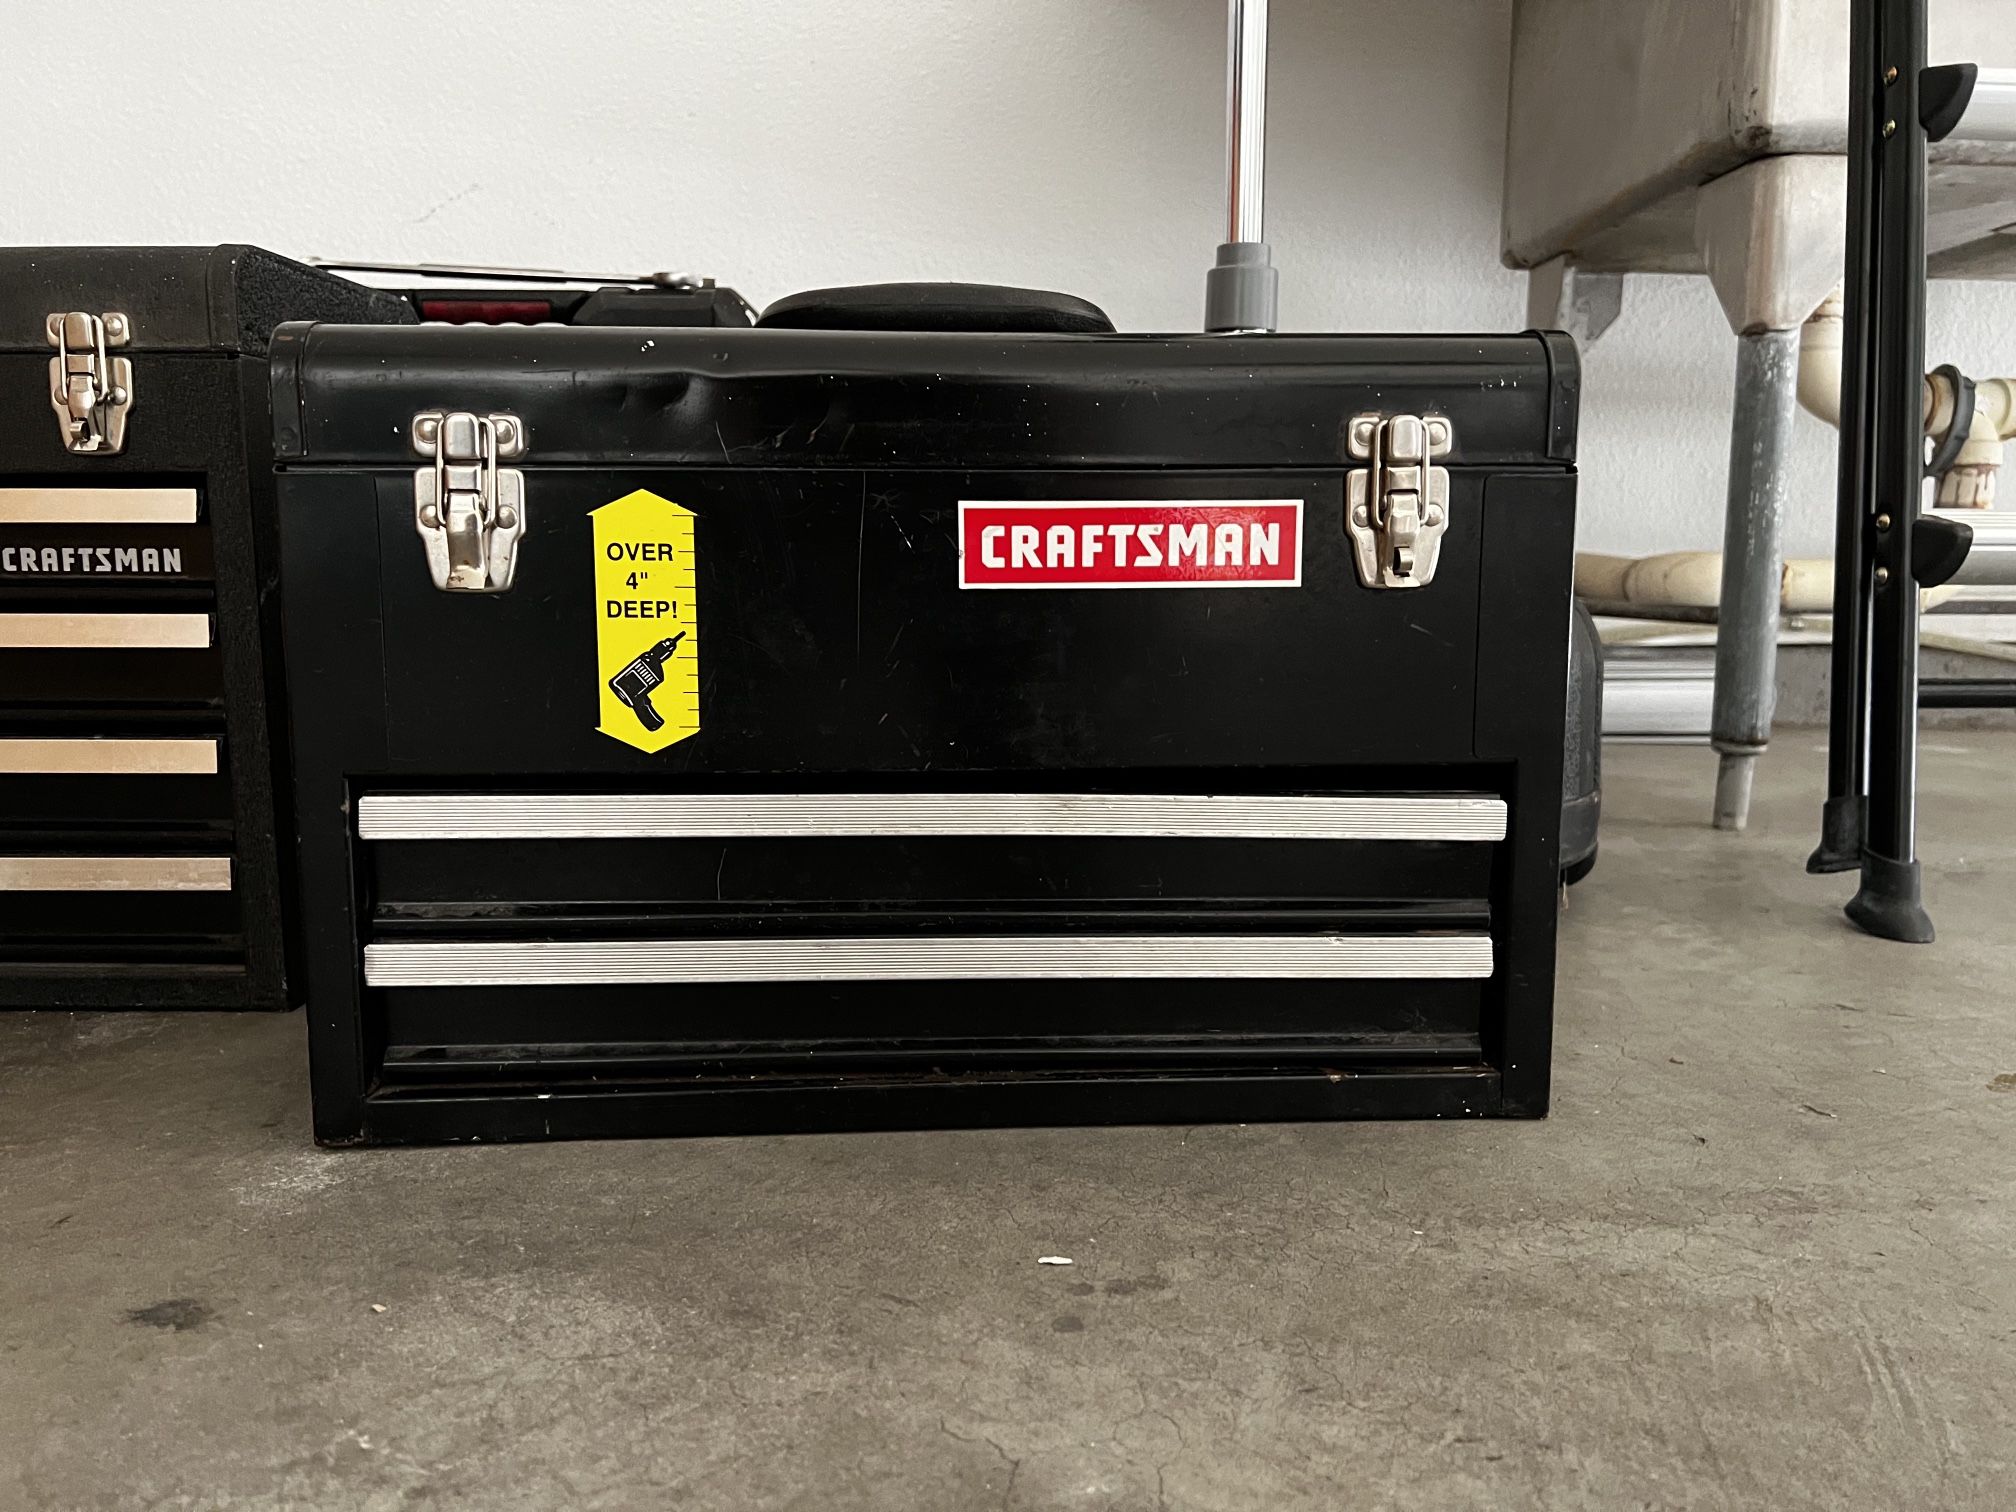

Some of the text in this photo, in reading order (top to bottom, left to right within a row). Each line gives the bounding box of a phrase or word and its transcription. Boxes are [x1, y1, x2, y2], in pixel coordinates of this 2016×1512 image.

[606, 542, 674, 562] OVER
[981, 523, 1280, 569] CRAFTSMAN
[1, 547, 182, 573] CRAFTSMAN
[625, 571, 649, 590] 4"
[606, 600, 678, 619] DEEP!
